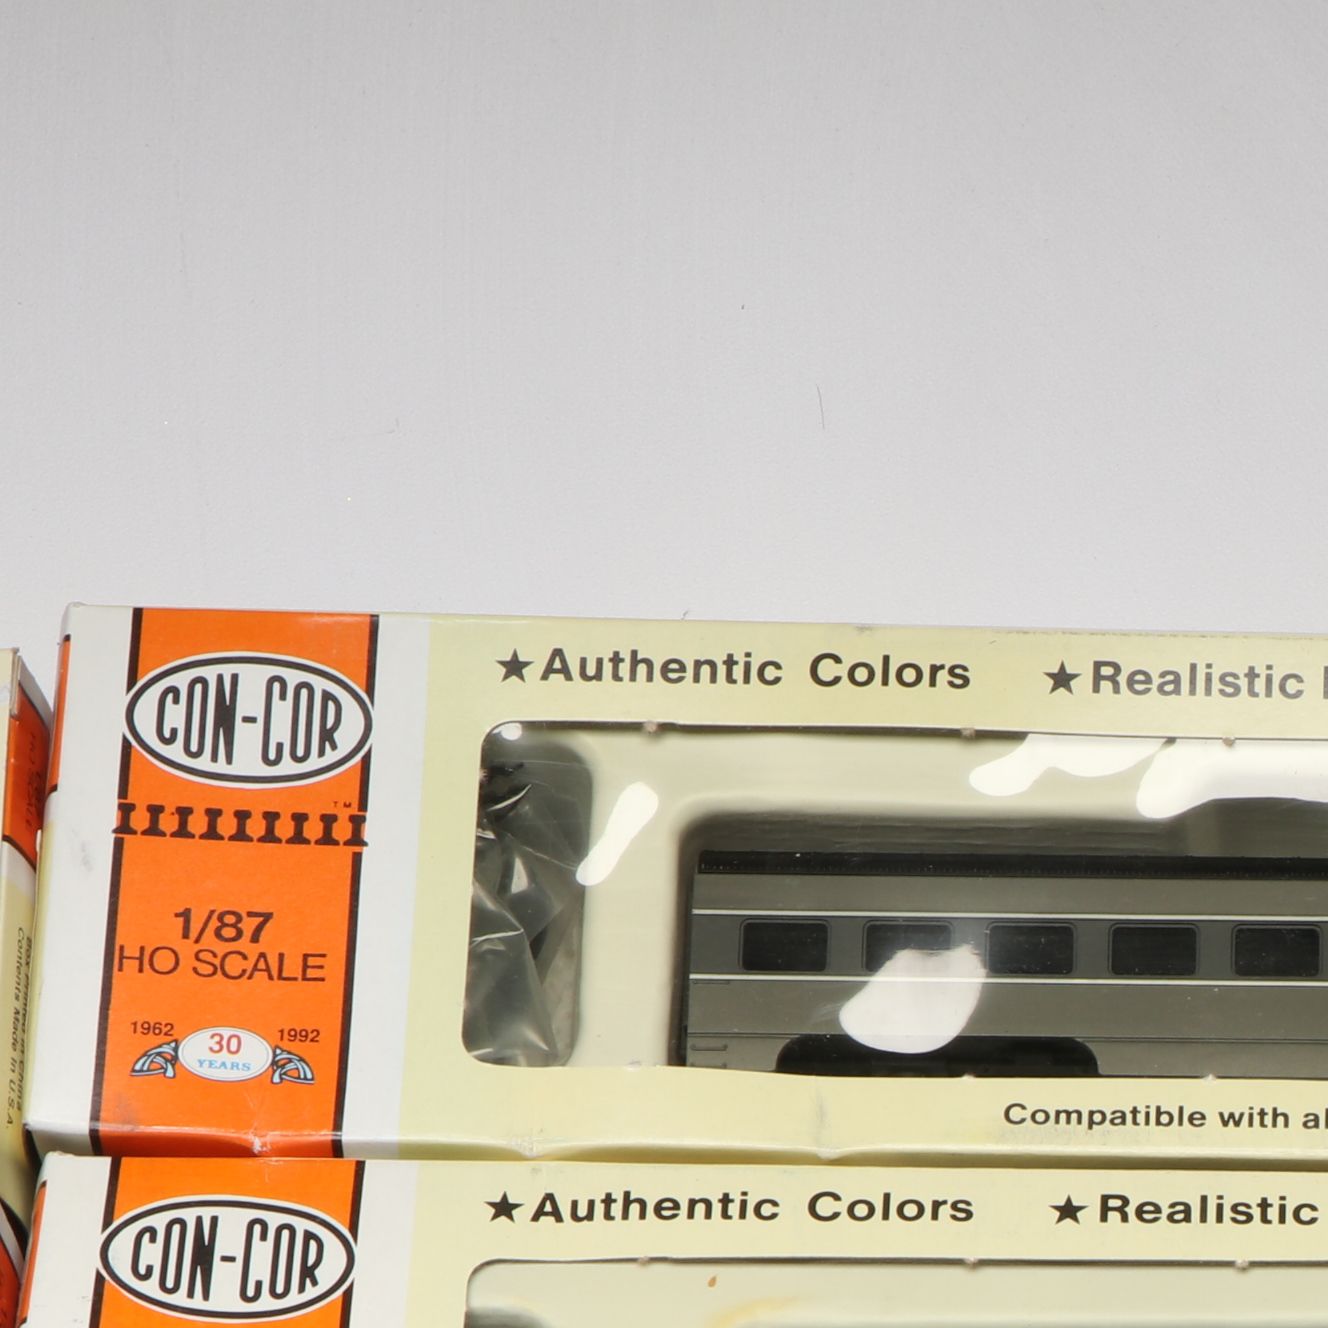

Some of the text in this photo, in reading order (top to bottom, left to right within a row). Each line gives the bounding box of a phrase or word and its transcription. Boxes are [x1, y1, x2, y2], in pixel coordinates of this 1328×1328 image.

[539, 647, 972, 690] Authentic Colors
[1091, 659, 1305, 701] Realistic
[156, 672, 343, 767] CON-COR
[173, 907, 274, 945] 1/87
[117, 944, 327, 983] HO SCALE
[11, 1007, 20, 1052] Made
[130, 1021, 321, 1043] 1962 1992
[207, 1032, 242, 1056] 30
[197, 1057, 251, 1072] YEARS
[1002, 1102, 1207, 1134] Compatible
[1218, 1105, 1290, 1131] with
[531, 1189, 976, 1226] Authentic Colors
[1097, 1193, 1320, 1227] Realistic
[130, 1214, 325, 1304] CON-COR
